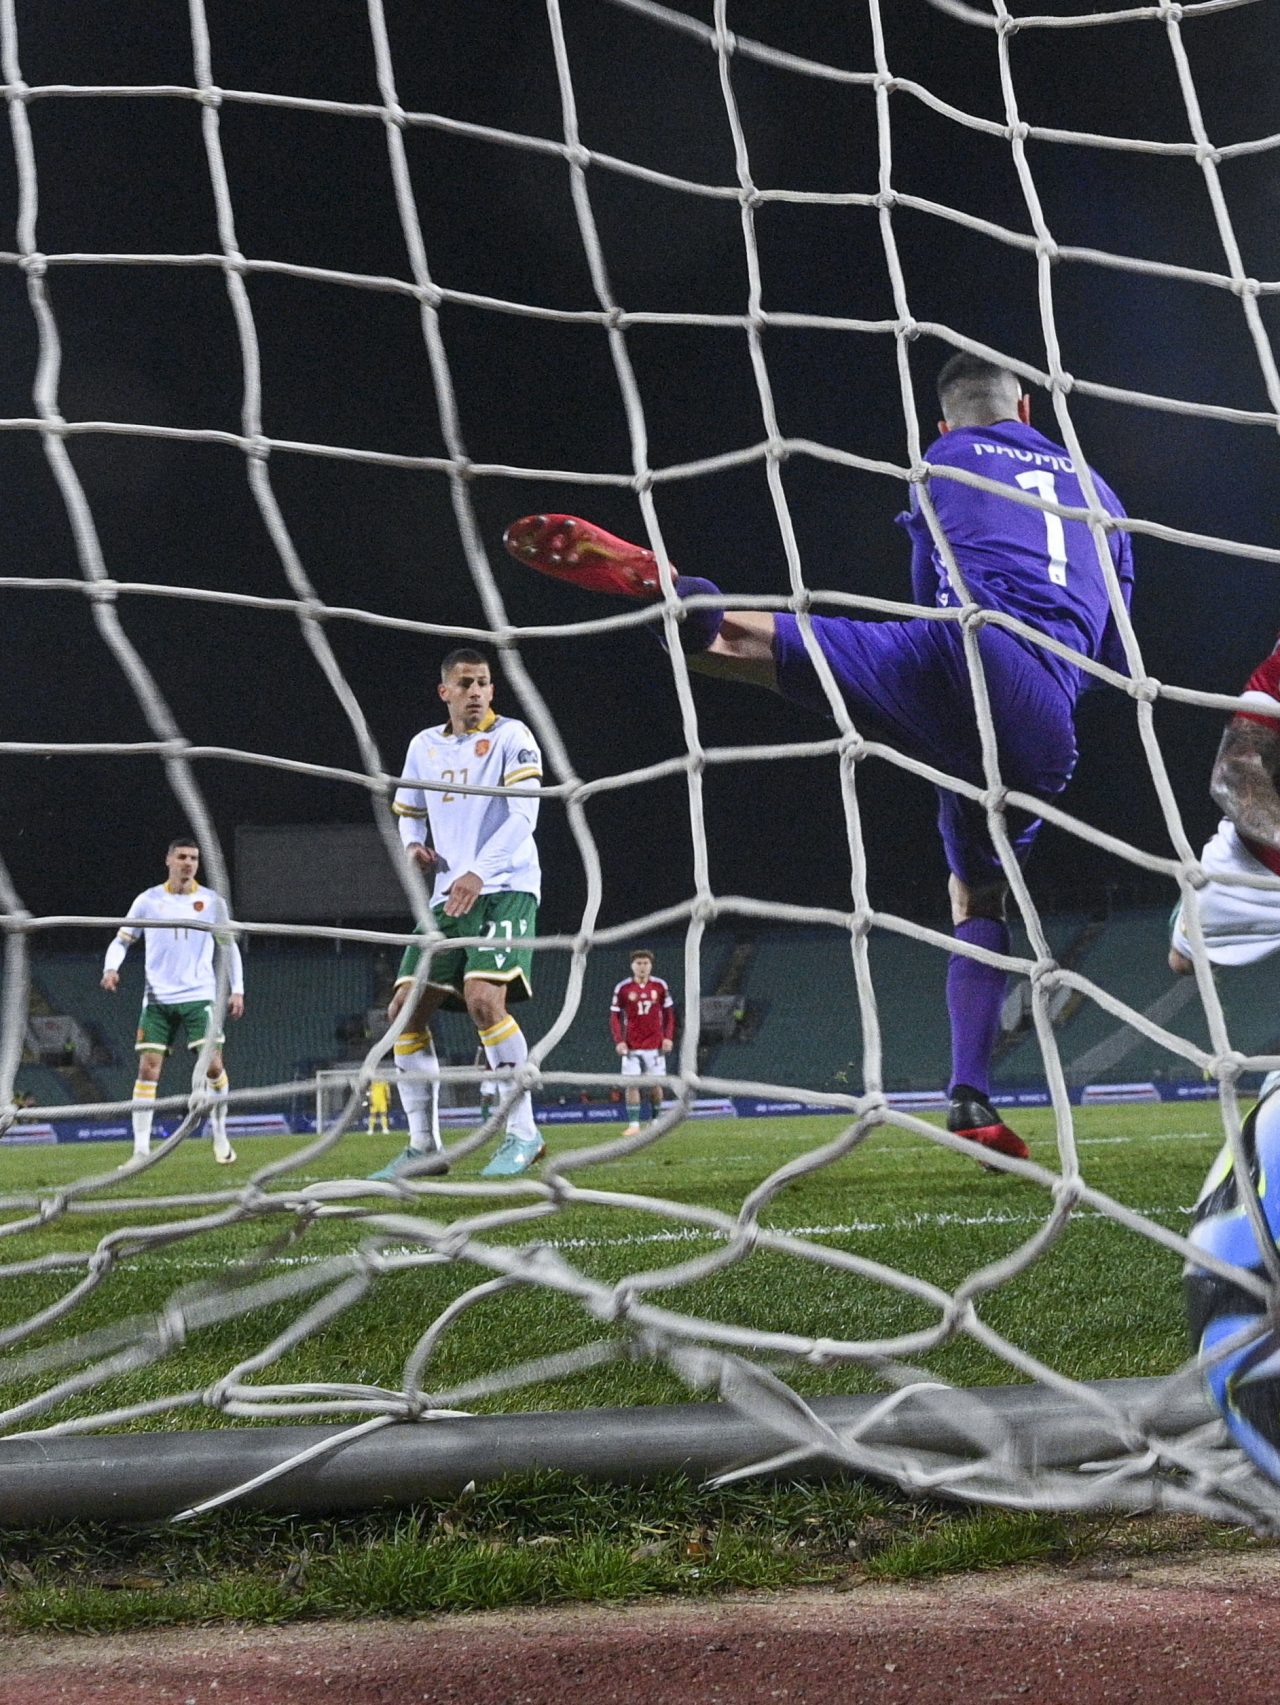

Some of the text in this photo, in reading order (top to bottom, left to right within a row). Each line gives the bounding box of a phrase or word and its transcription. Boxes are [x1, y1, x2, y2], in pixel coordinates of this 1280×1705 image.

[1014, 469, 1067, 587] 1
[441, 767, 469, 803] 21
[477, 919, 513, 954] 21
[637, 1000, 653, 1016] 17
